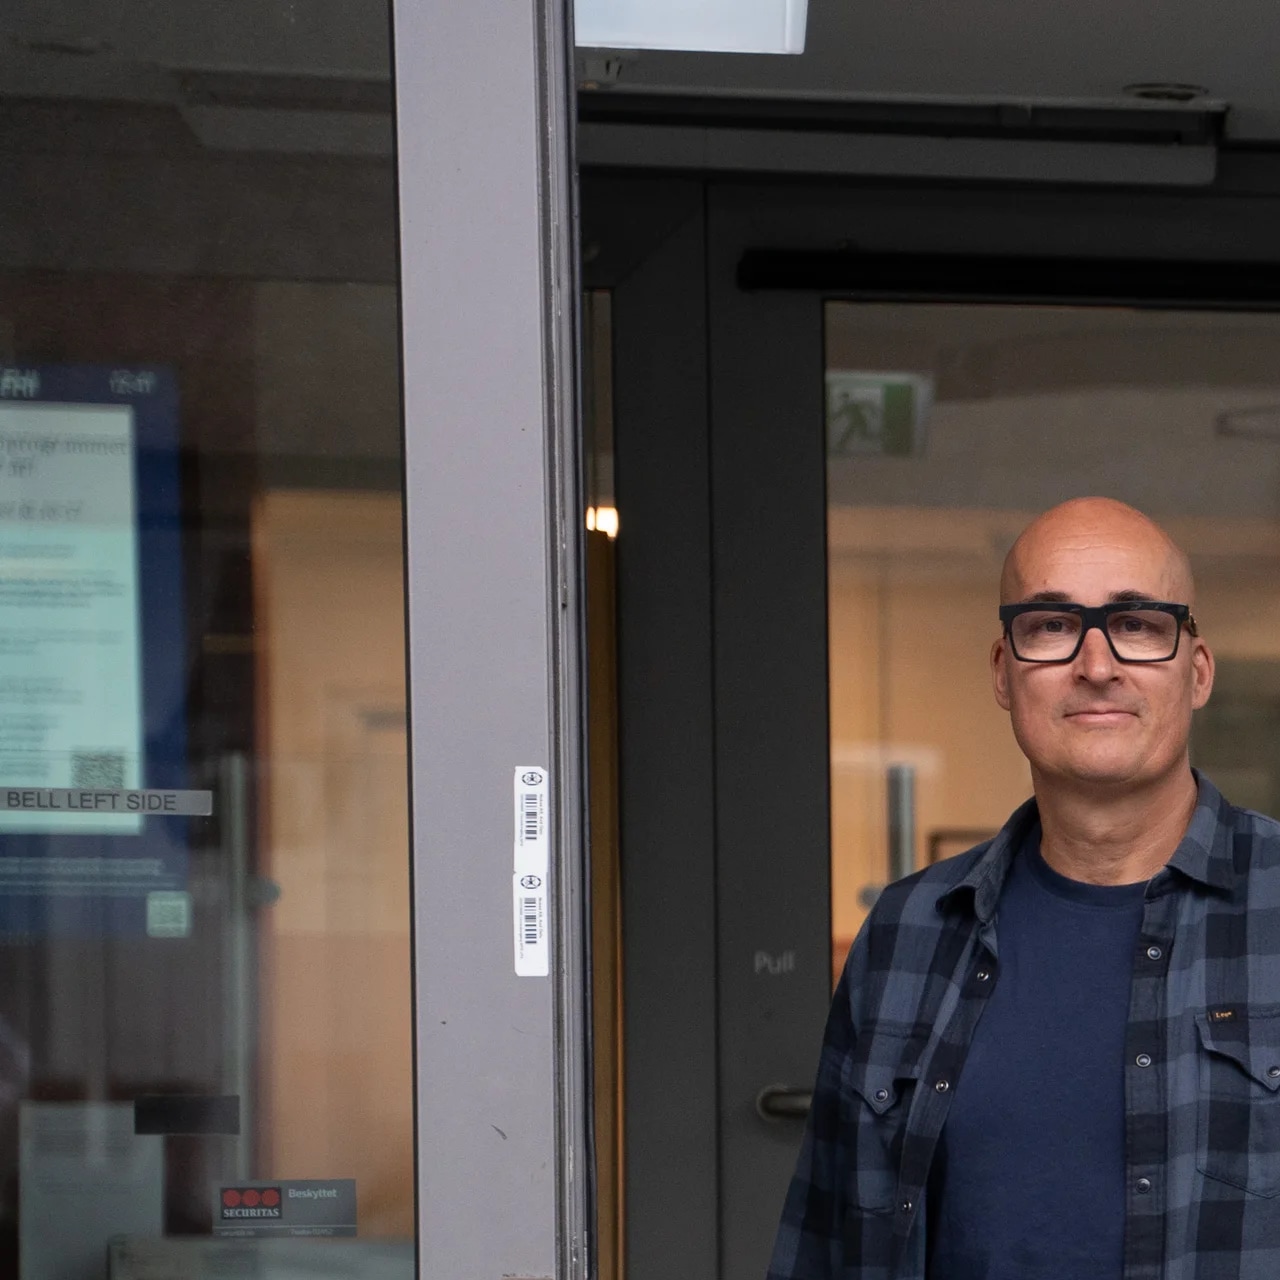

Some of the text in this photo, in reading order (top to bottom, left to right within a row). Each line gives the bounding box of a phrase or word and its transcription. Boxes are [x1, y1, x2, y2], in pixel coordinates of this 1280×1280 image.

[7, 792, 177, 811] BELL LEFT SIDE
[755, 950, 795, 974] Pull
[288, 1188, 337, 1200] Beskyttet
[223, 1209, 279, 1217] SECURITAS
